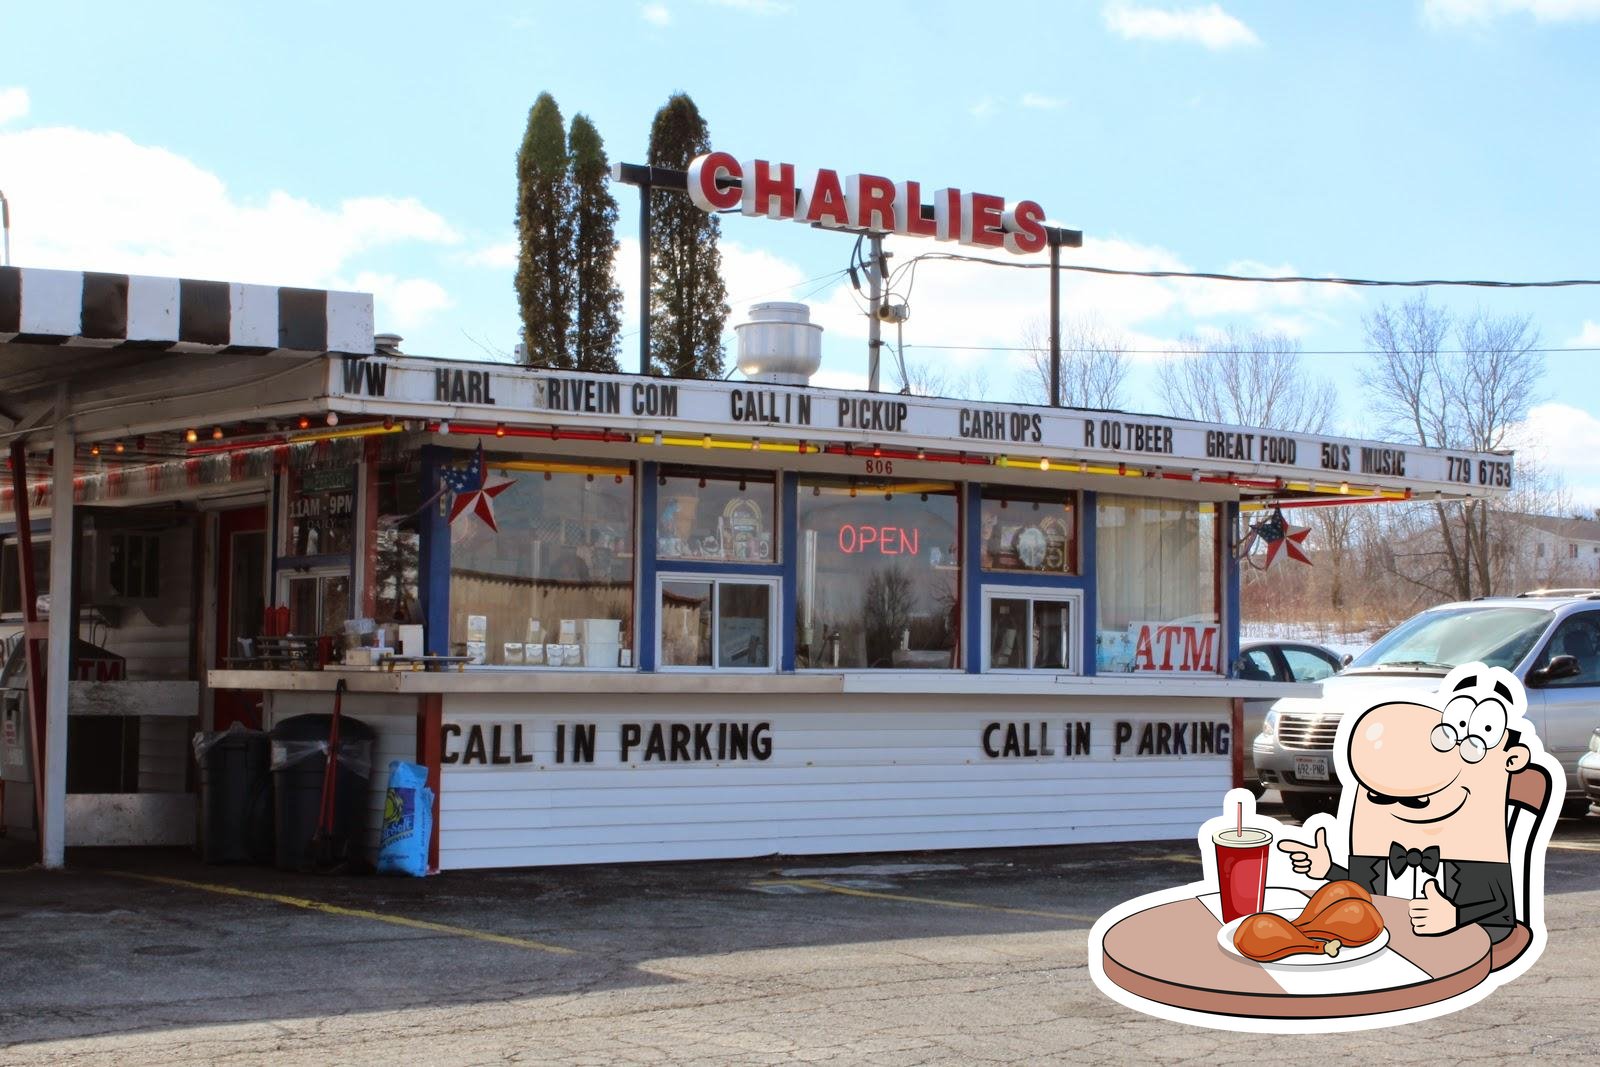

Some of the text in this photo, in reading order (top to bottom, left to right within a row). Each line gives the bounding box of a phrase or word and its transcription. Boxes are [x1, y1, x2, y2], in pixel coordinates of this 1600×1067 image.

[688, 151, 1048, 254] CHARLIES
[435, 367, 496, 405] HARL
[632, 382, 678, 417] COM
[838, 398, 908, 431] PICKUP
[1206, 430, 1254, 461] GREAT
[1260, 438, 1296, 465] FOOD
[1361, 447, 1406, 477] MUSIC
[1447, 456, 1471, 483] 779
[1479, 460, 1512, 488] 6753
[866, 460, 893, 475] 806
[289, 498, 320, 518] 11AM
[838, 524, 919, 556] OPEN
[1134, 624, 1217, 672] ATM
[76, 659, 121, 681] TM
[441, 721, 773, 765] CALL IN PARKING
[982, 722, 1055, 758] CALL
[1114, 721, 1231, 756] PARKING
